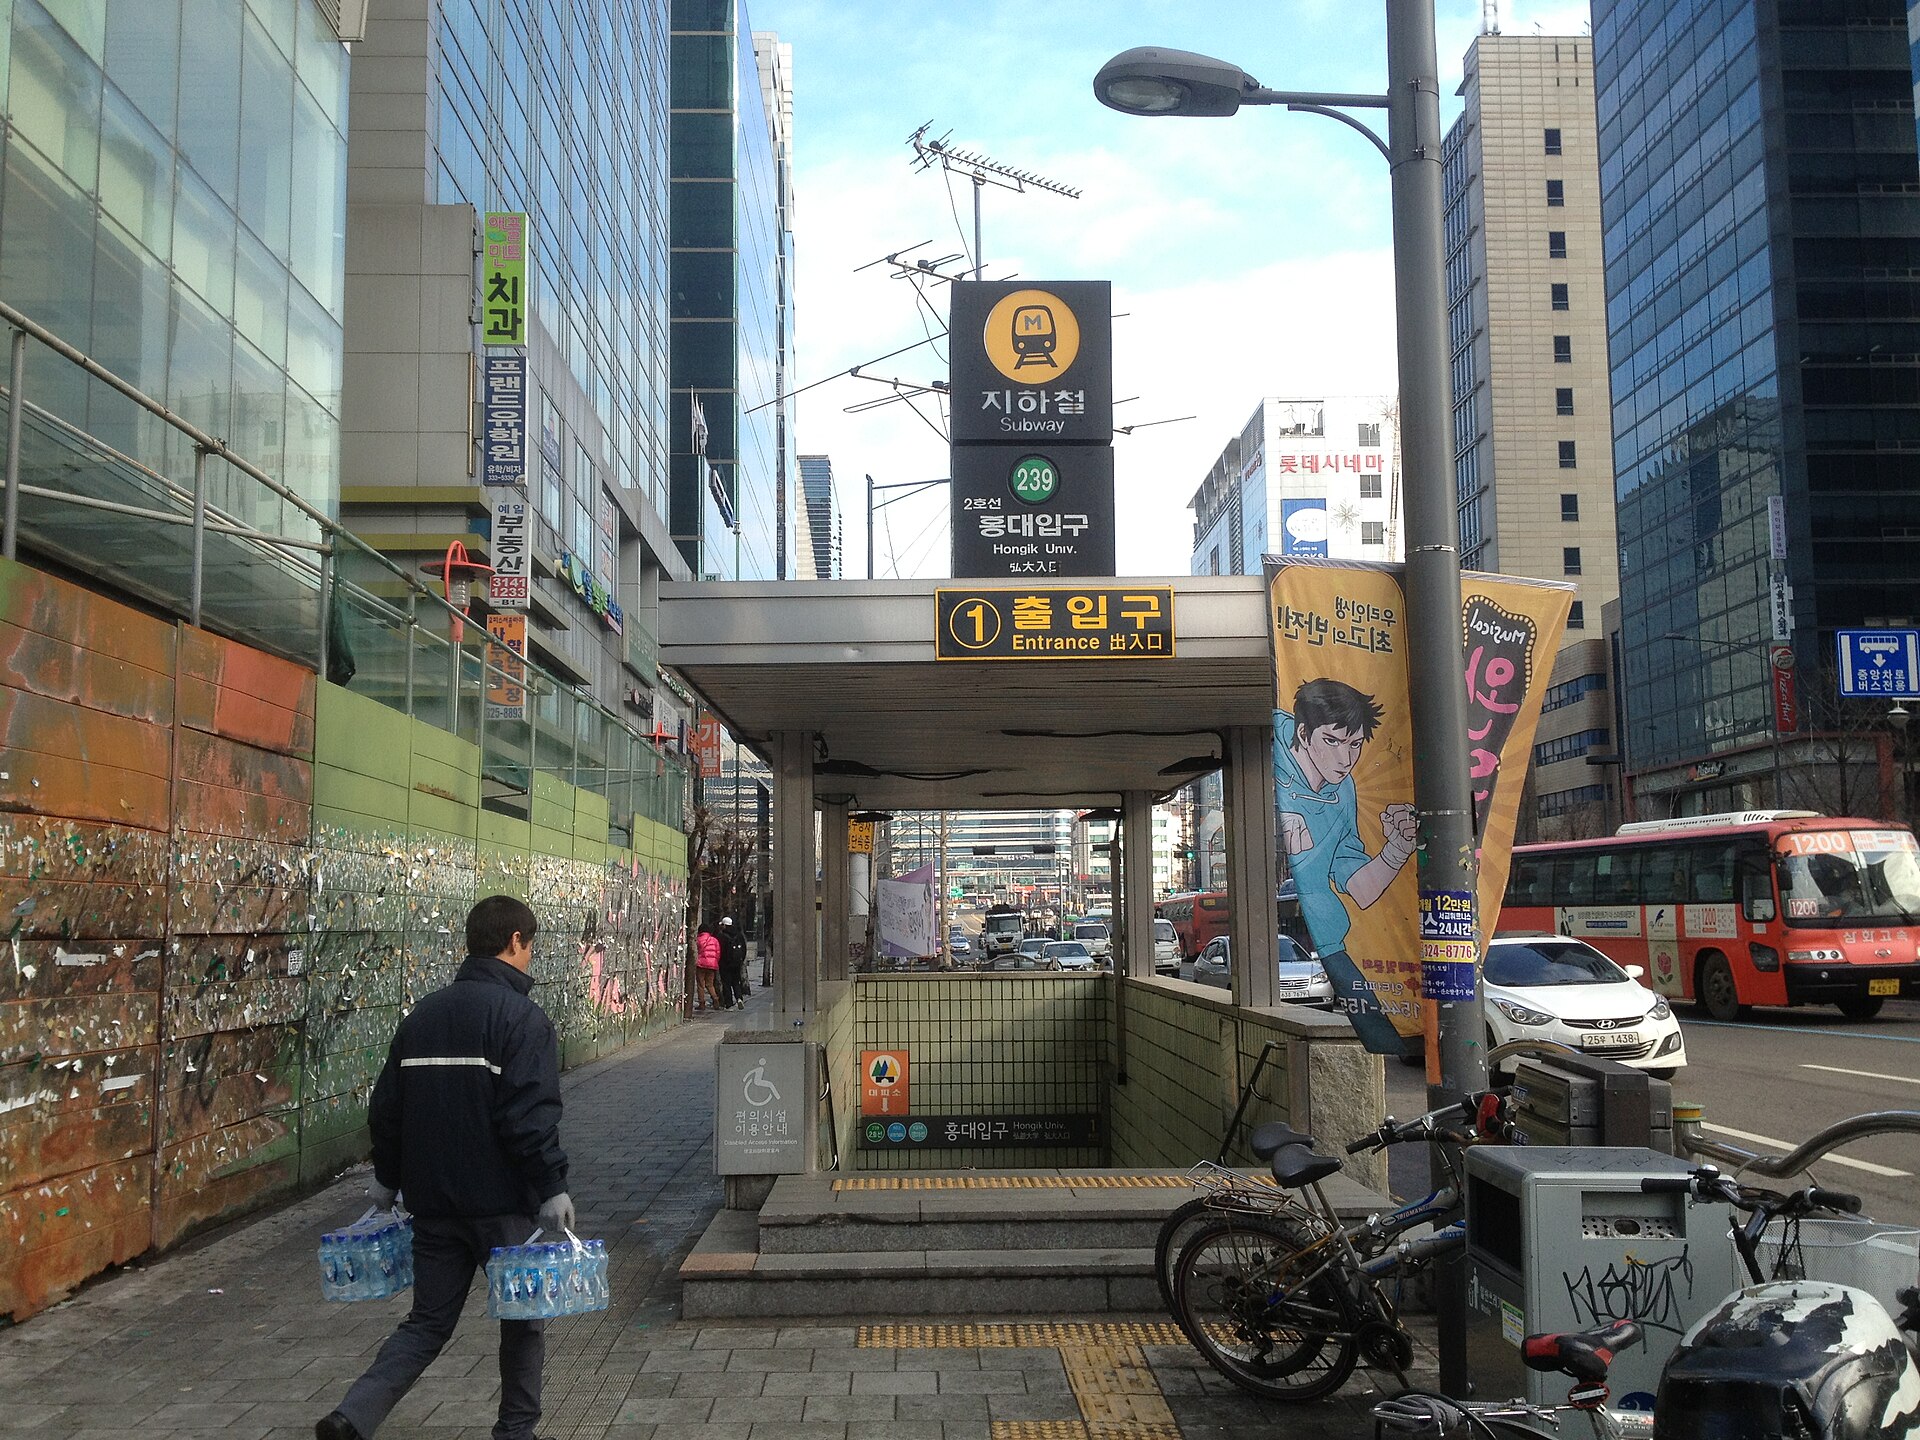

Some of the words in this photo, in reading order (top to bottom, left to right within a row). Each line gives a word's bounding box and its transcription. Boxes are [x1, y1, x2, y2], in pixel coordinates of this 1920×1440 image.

[486, 271, 522, 341] 치과
[1023, 314, 1042, 331] M
[981, 389, 1085, 415] 지하철
[487, 360, 523, 462] 프랜드유학원
[1000, 417, 1065, 435] Subway
[1279, 454, 1385, 474] 롯데시네마
[1017, 467, 1053, 492] 239
[963, 497, 1002, 511] 2호선
[978, 513, 1089, 537] 홍대입구
[495, 515, 524, 575] 부동산
[993, 544, 1039, 556] Hongik
[1045, 543, 1078, 554] Univ.
[492, 577, 526, 588] 3141
[491, 588, 526, 597] 1233
[1011, 595, 1161, 630] 출입구
[1012, 634, 1100, 650] Entrance
[1110, 632, 1162, 651] 出入口
[1857, 668, 1906, 680] 중앙차로
[1778, 670, 1791, 700] Pizza
[1858, 680, 1906, 692] 버스전용
[702, 723, 719, 769] 가발
[1790, 833, 1846, 853] 1200
[1435, 894, 1471, 912] 12만원
[1791, 900, 1818, 915] 1200
[1438, 922, 1472, 936] 24시간
[1843, 930, 1909, 944] 삼화고속
[1611, 1034, 1634, 1044] 1438
[868, 1088, 902, 1097] 대피소
[735, 1109, 786, 1123] 편의시설
[735, 1122, 788, 1136] 이용안내
[944, 1121, 1009, 1141] 홍대입구
[1013, 1121, 1043, 1132] Hongik
